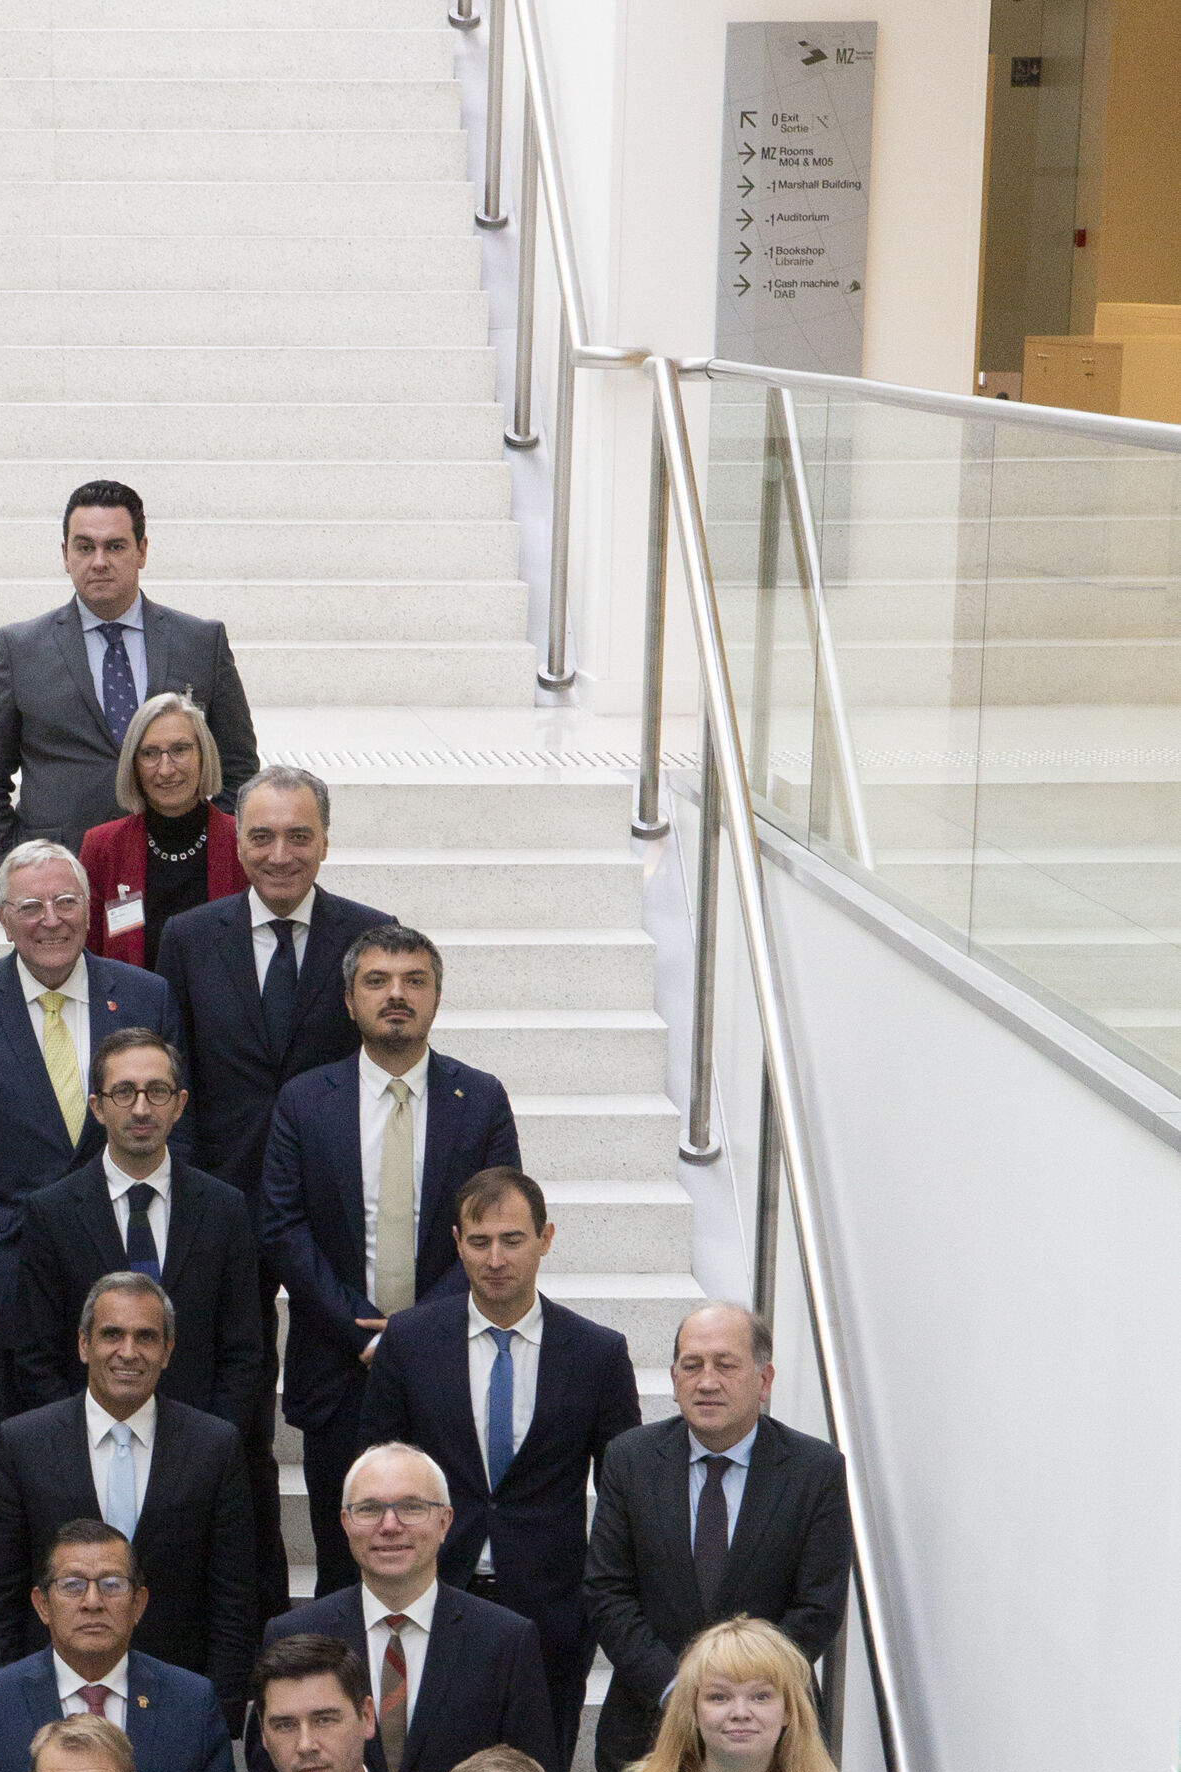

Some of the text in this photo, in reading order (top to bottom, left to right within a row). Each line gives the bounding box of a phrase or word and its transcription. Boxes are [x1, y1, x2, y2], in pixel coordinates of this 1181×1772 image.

[836, 48, 854, 64] MZ
[772, 113, 799, 126] 0 Exit
[780, 124, 809, 133] Sortie
[761, 147, 813, 160] MZ Rooms
[779, 158, 833, 166] M04 & M05
[766, 180, 861, 192] -1 Marshall Building
[765, 213, 829, 226] -1 Auditorium
[764, 247, 824, 258] -1 Bookshop
[775, 258, 814, 266] Librairie
[763, 279, 839, 292] -1 Cash machine
[774, 290, 795, 298] DAB
